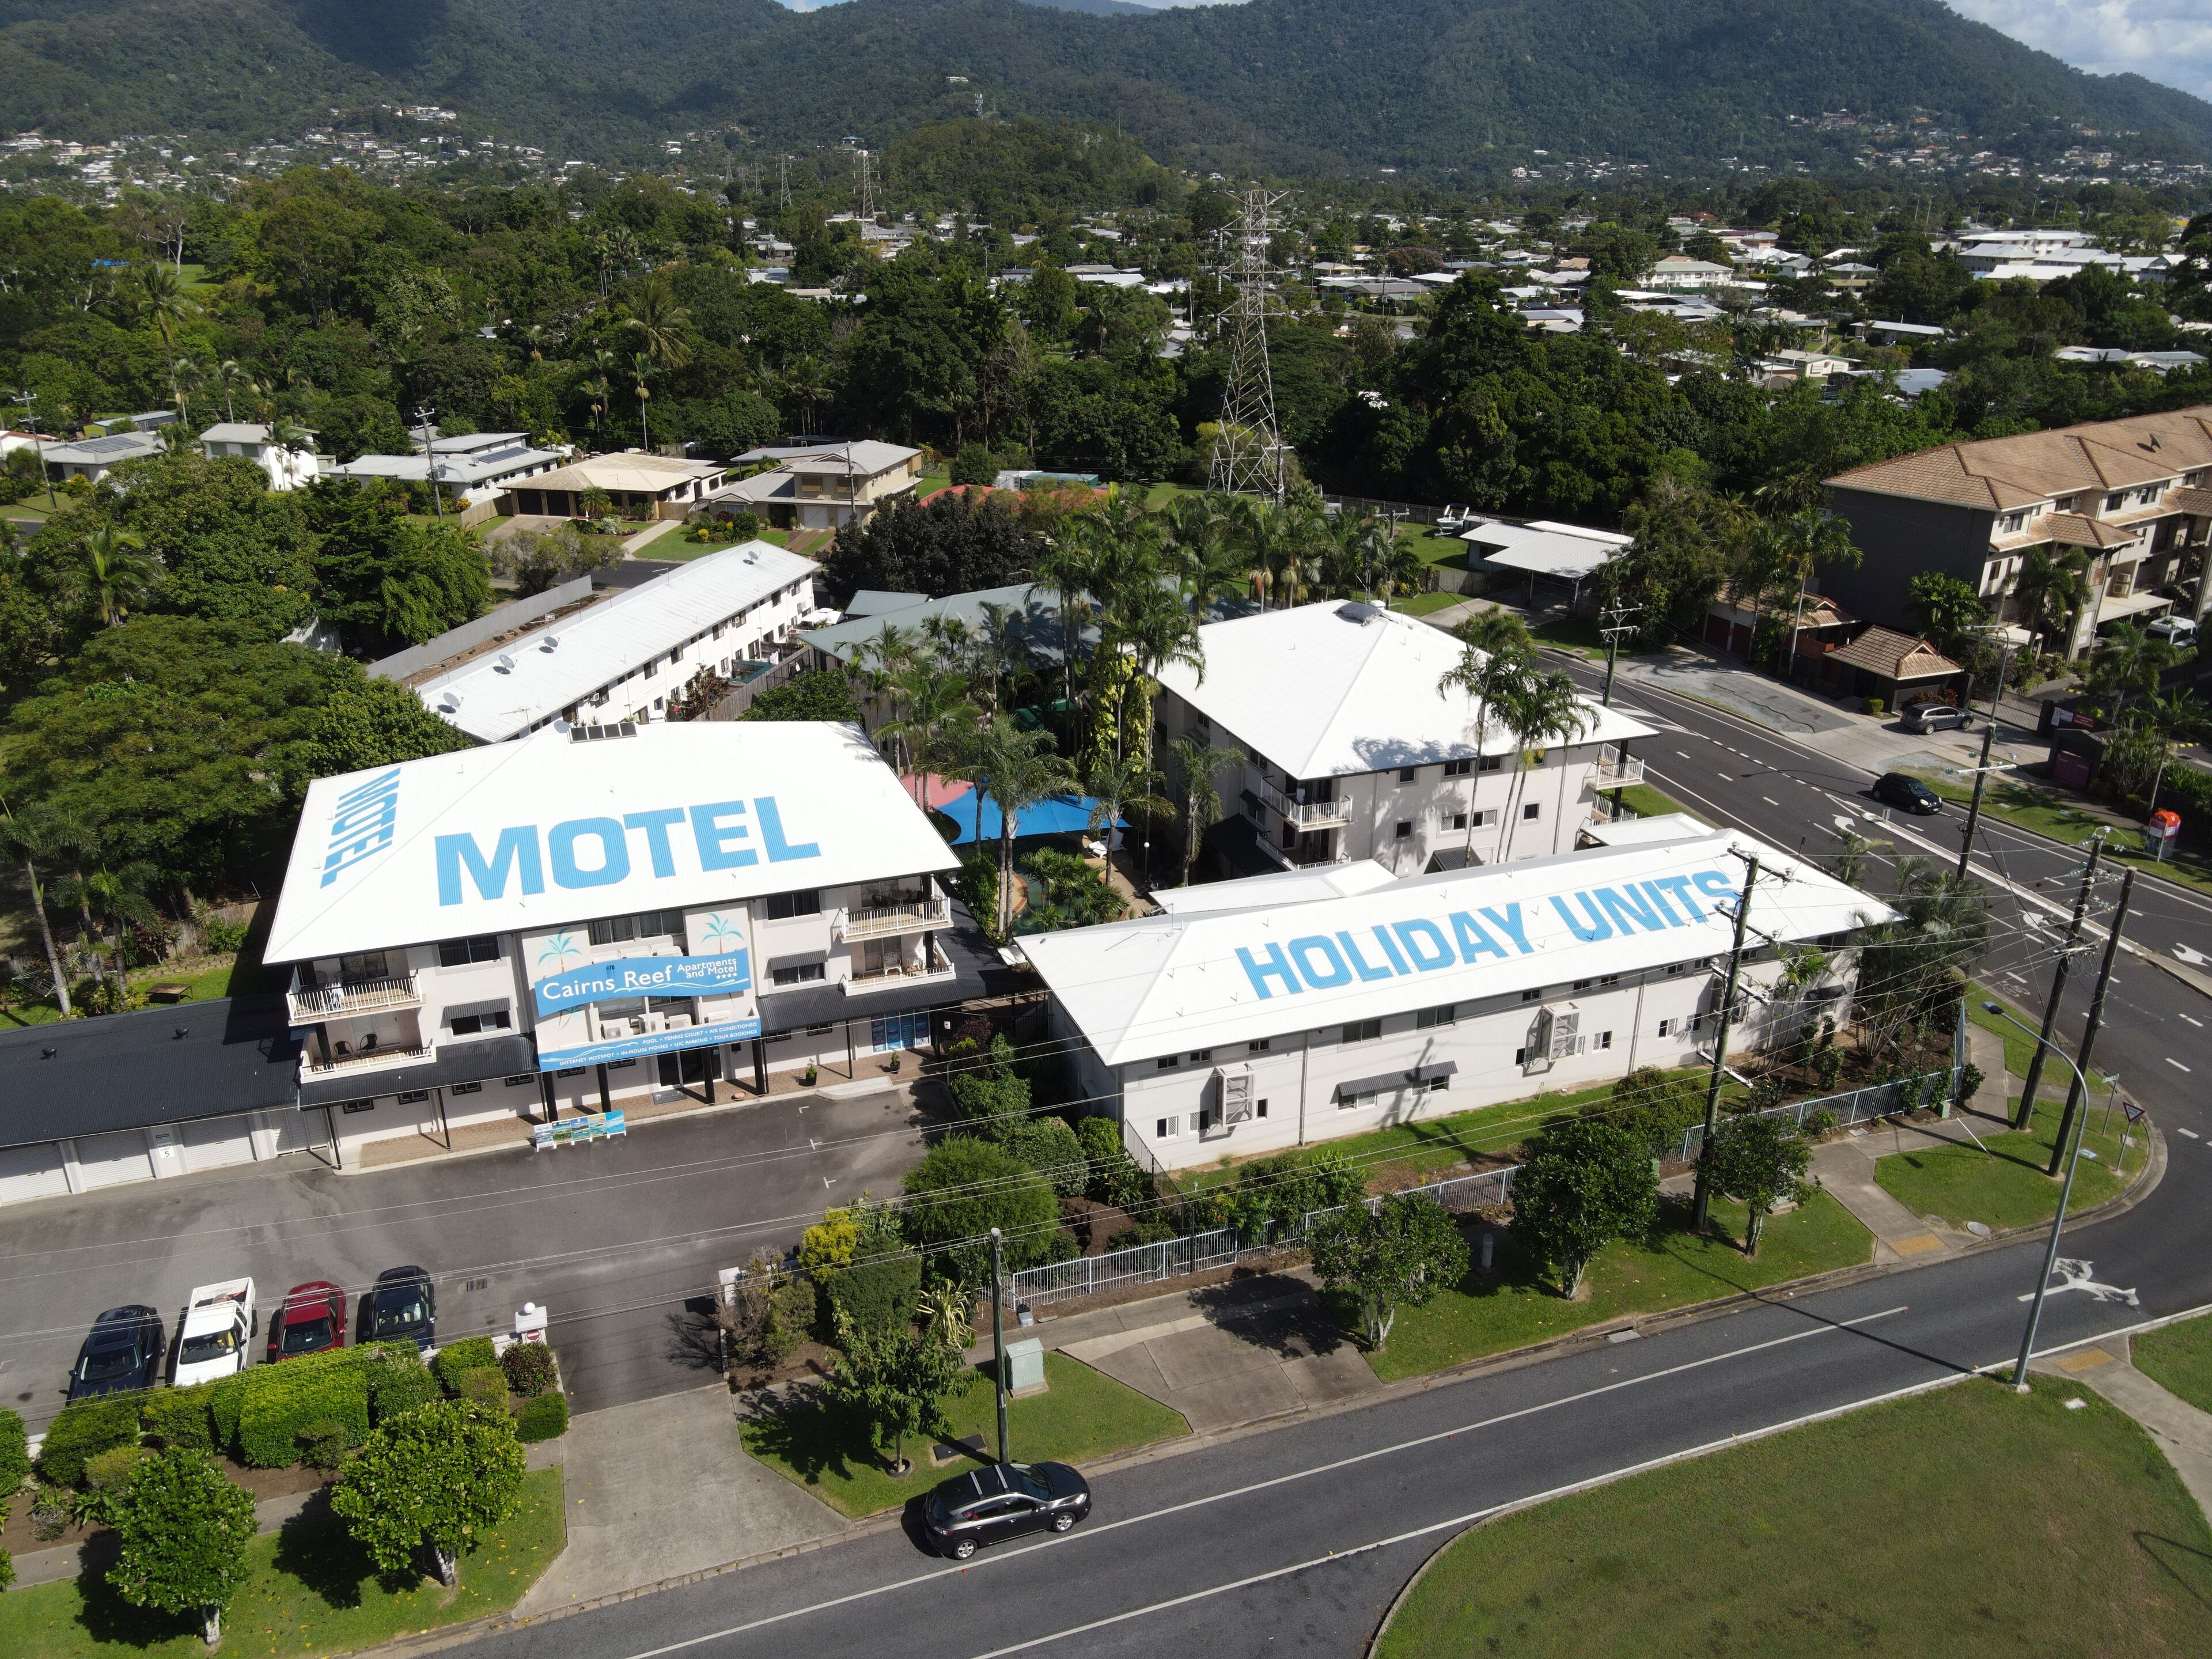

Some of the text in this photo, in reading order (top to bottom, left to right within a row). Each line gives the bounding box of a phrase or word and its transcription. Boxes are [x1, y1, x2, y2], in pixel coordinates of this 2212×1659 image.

[320, 767, 401, 889] MOTEL
[434, 796, 822, 907] MOTEL
[1234, 870, 1752, 1000] HOLIDAY UNITS
[543, 965, 672, 999] Cairns Reef
[677, 958, 737, 973] Apartments
[686, 963, 737, 979] and Motel
[719, 1022, 757, 1032] CONDITIONED
[559, 1057, 587, 1066] INTERNET
[588, 1052, 615, 1062] HOTSPOT
[621, 1047, 648, 1055] IN-HOUSE
[730, 1029, 757, 1037] BOOKINGS
